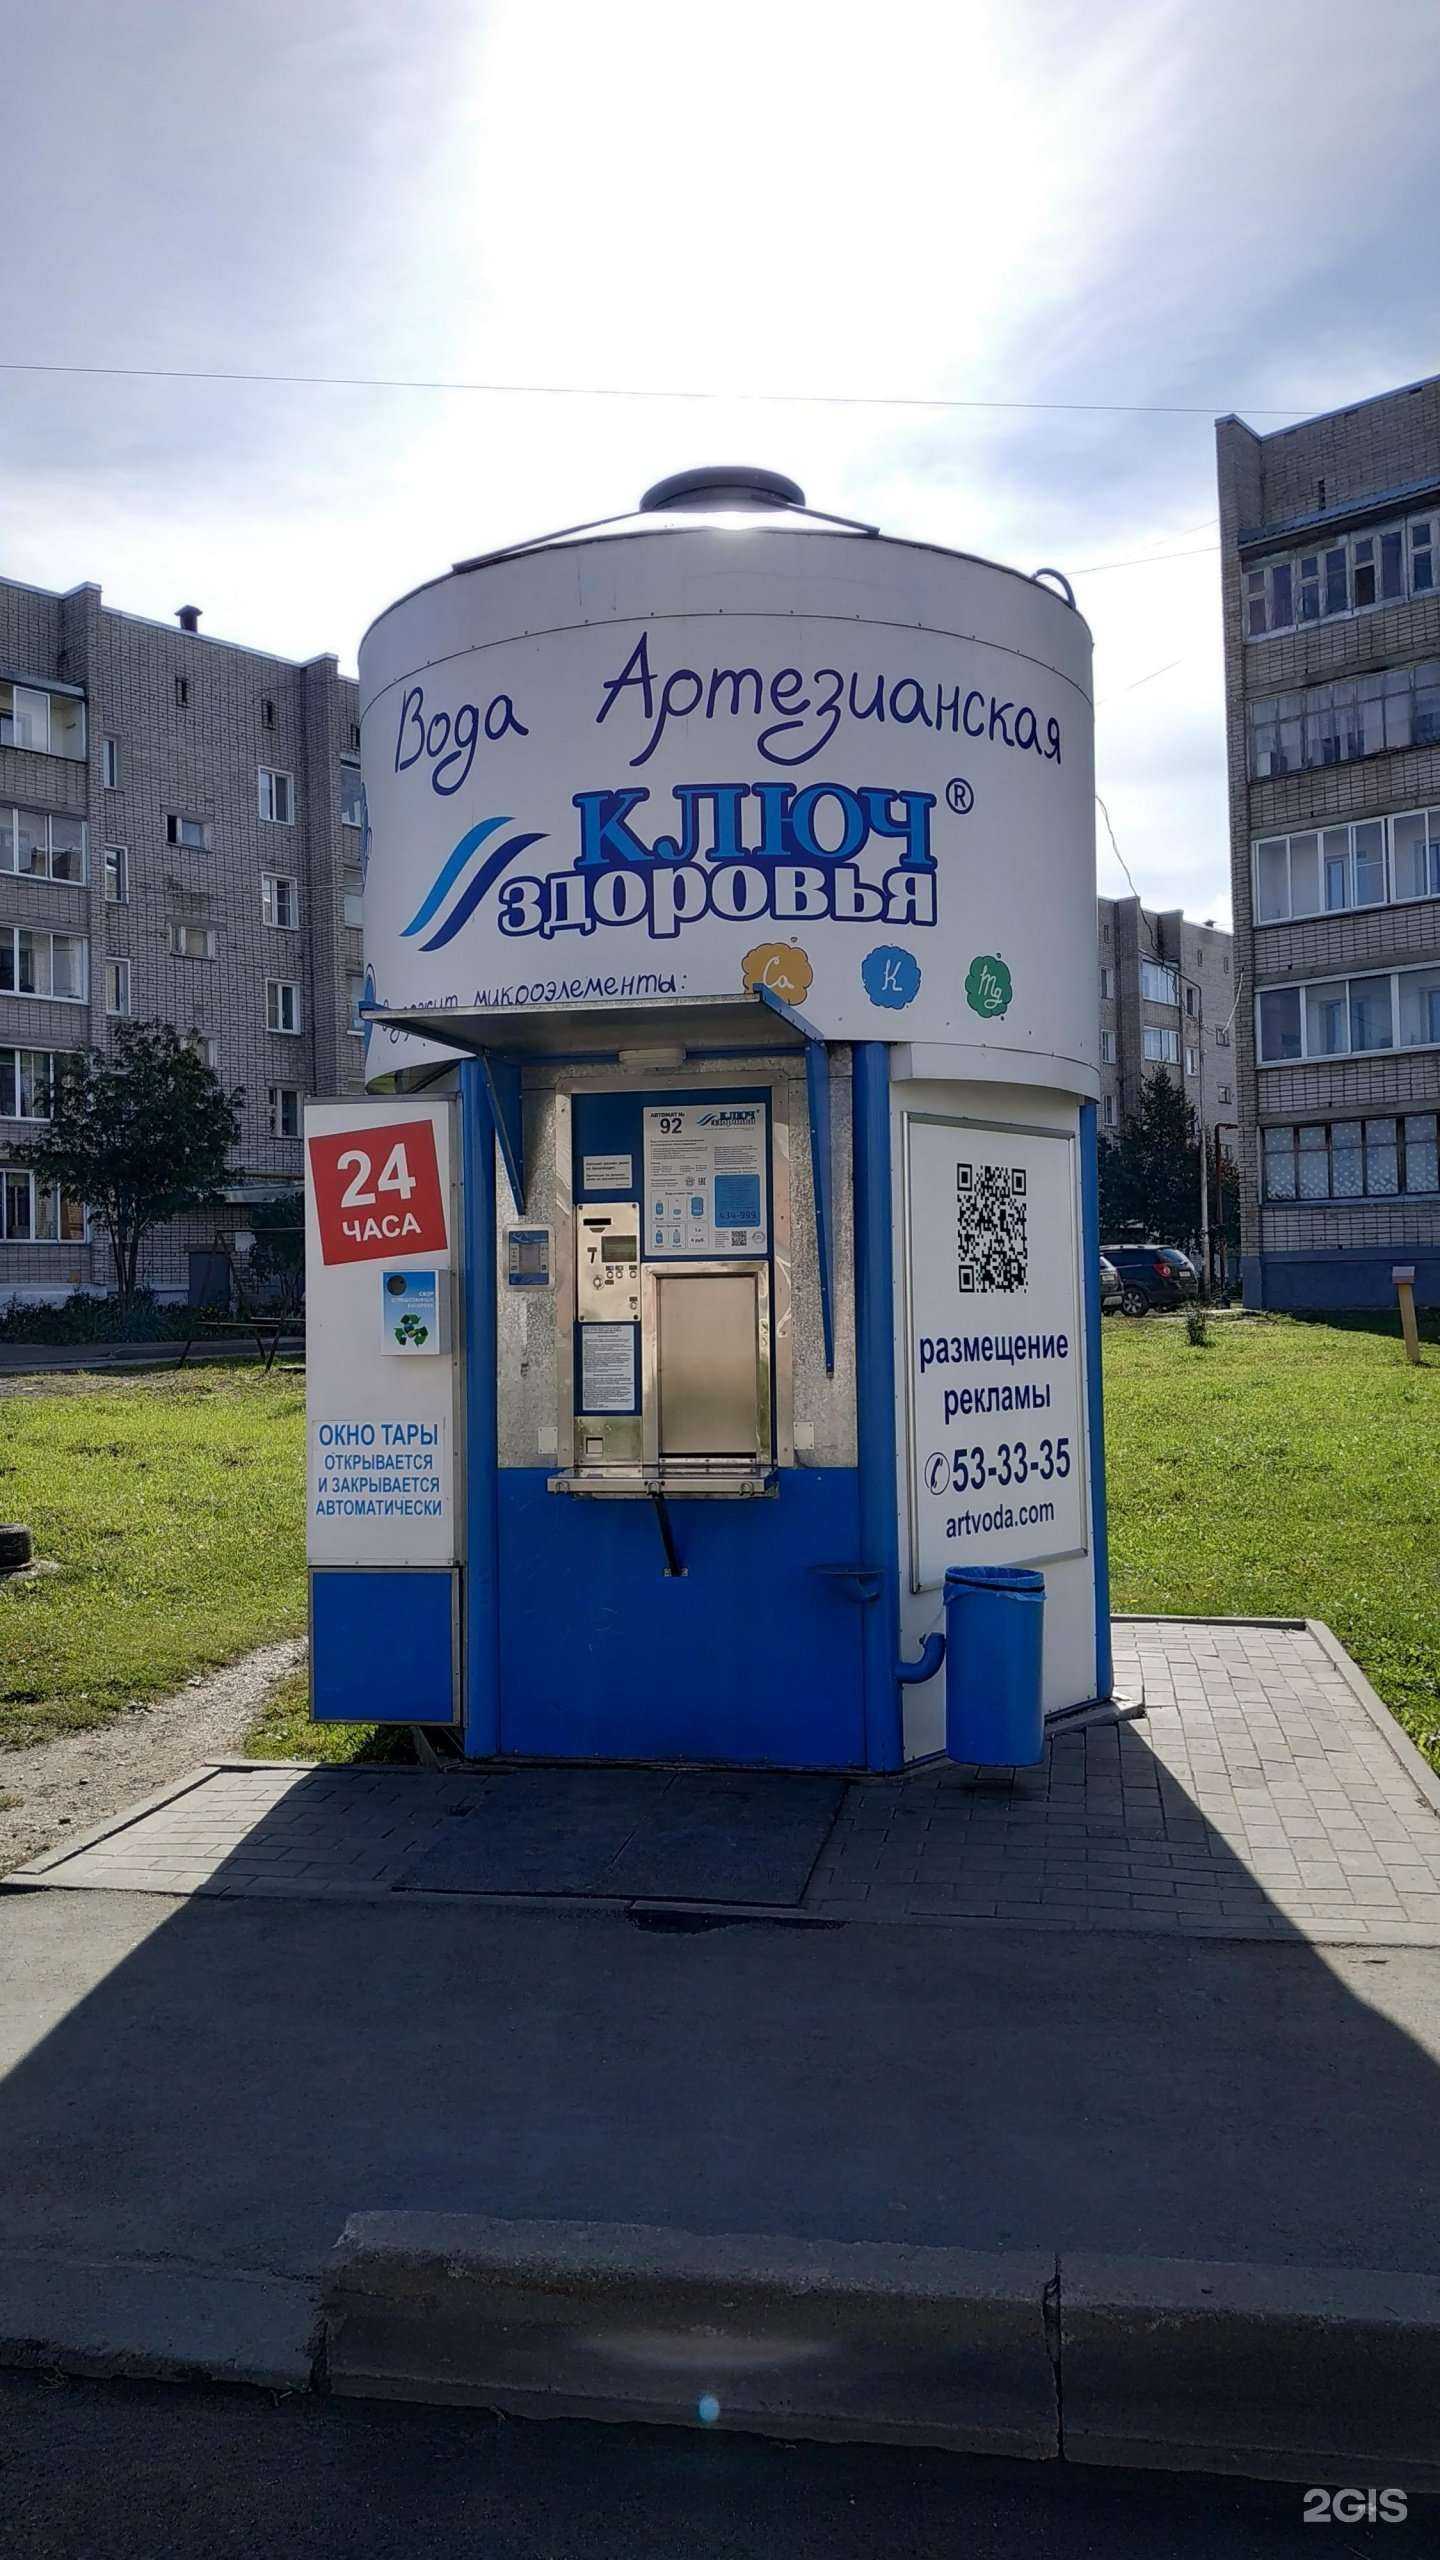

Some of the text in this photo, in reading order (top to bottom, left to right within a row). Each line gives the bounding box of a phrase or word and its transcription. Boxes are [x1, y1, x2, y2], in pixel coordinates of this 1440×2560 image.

[395, 631, 1061, 796] Вода Артезианская
[572, 782, 937, 866] КЛЮЧ
[498, 862, 937, 940] здоровья
[660, 1118, 682, 1134] 92
[337, 1143, 416, 1209] 24
[342, 1212, 422, 1242] ЧАСА
[920, 1333, 1069, 1373] размещение
[944, 1383, 1051, 1425] рекламы
[319, 1424, 438, 1446] ОКНО ТАРЫ
[324, 1454, 433, 1470] ОТКРЫВАЕТСЯ
[952, 1437, 1070, 1492] 53-33-35
[318, 1477, 440, 1493] И ЗАКРЫВАЕТСЯ
[316, 1500, 442, 1516] АВТОМАТИЧЕСКИ
[946, 1502, 1055, 1538] artvoda.com
